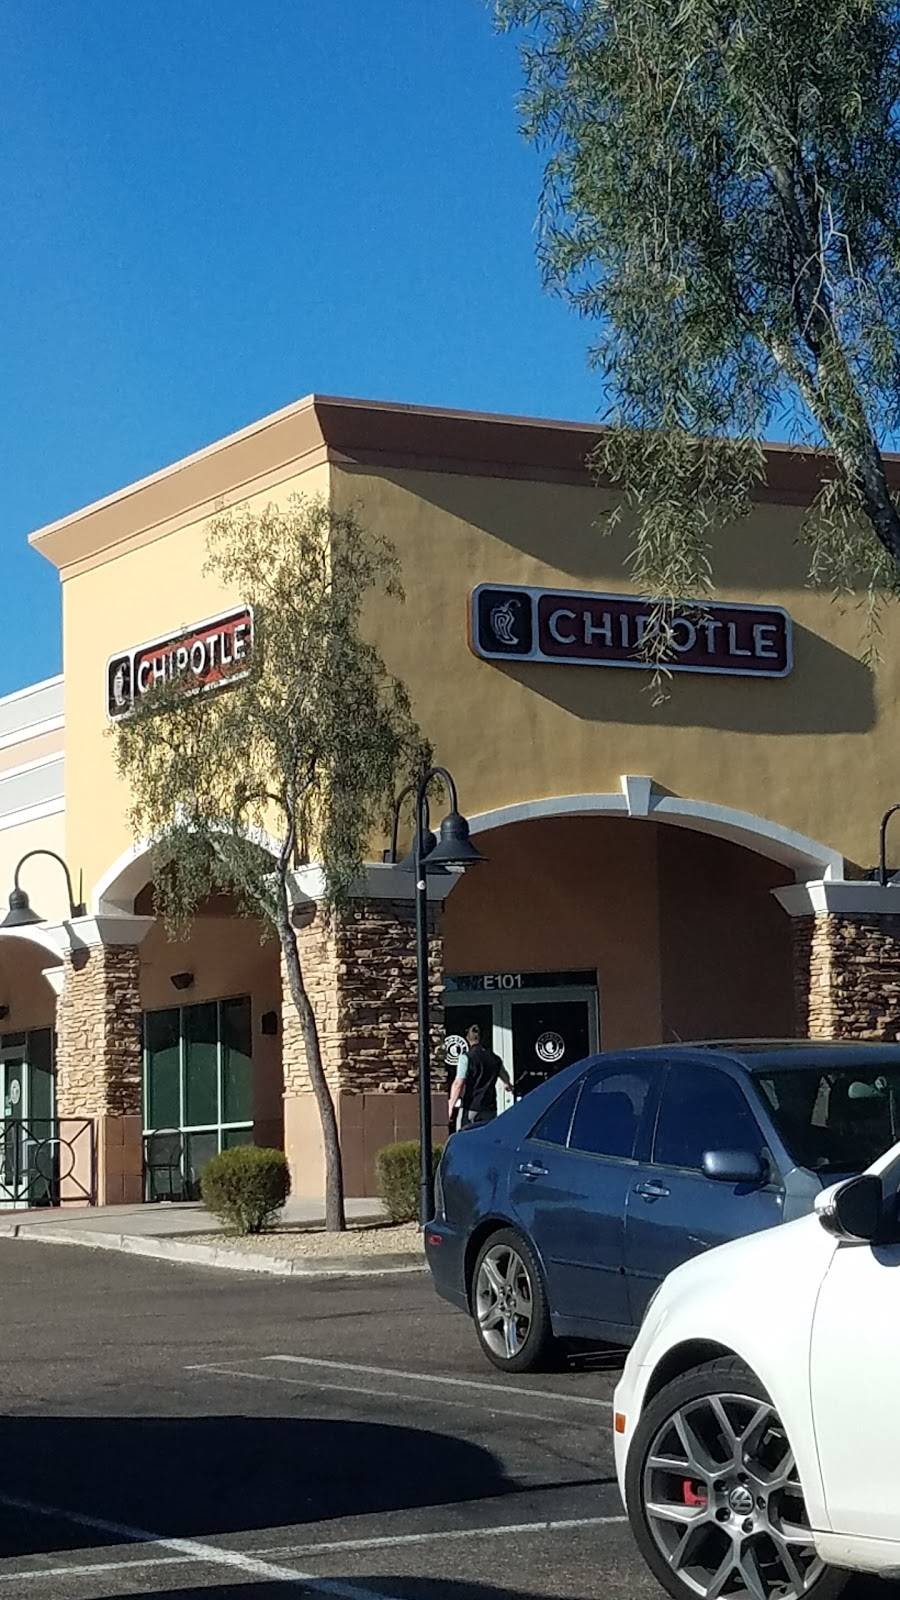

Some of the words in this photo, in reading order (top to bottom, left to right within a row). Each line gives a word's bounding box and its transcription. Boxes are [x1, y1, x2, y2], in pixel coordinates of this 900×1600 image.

[549, 609, 778, 658] CHIPOTLE
[137, 624, 246, 693] CHIPOTLE
[484, 974, 521, 989] E101
